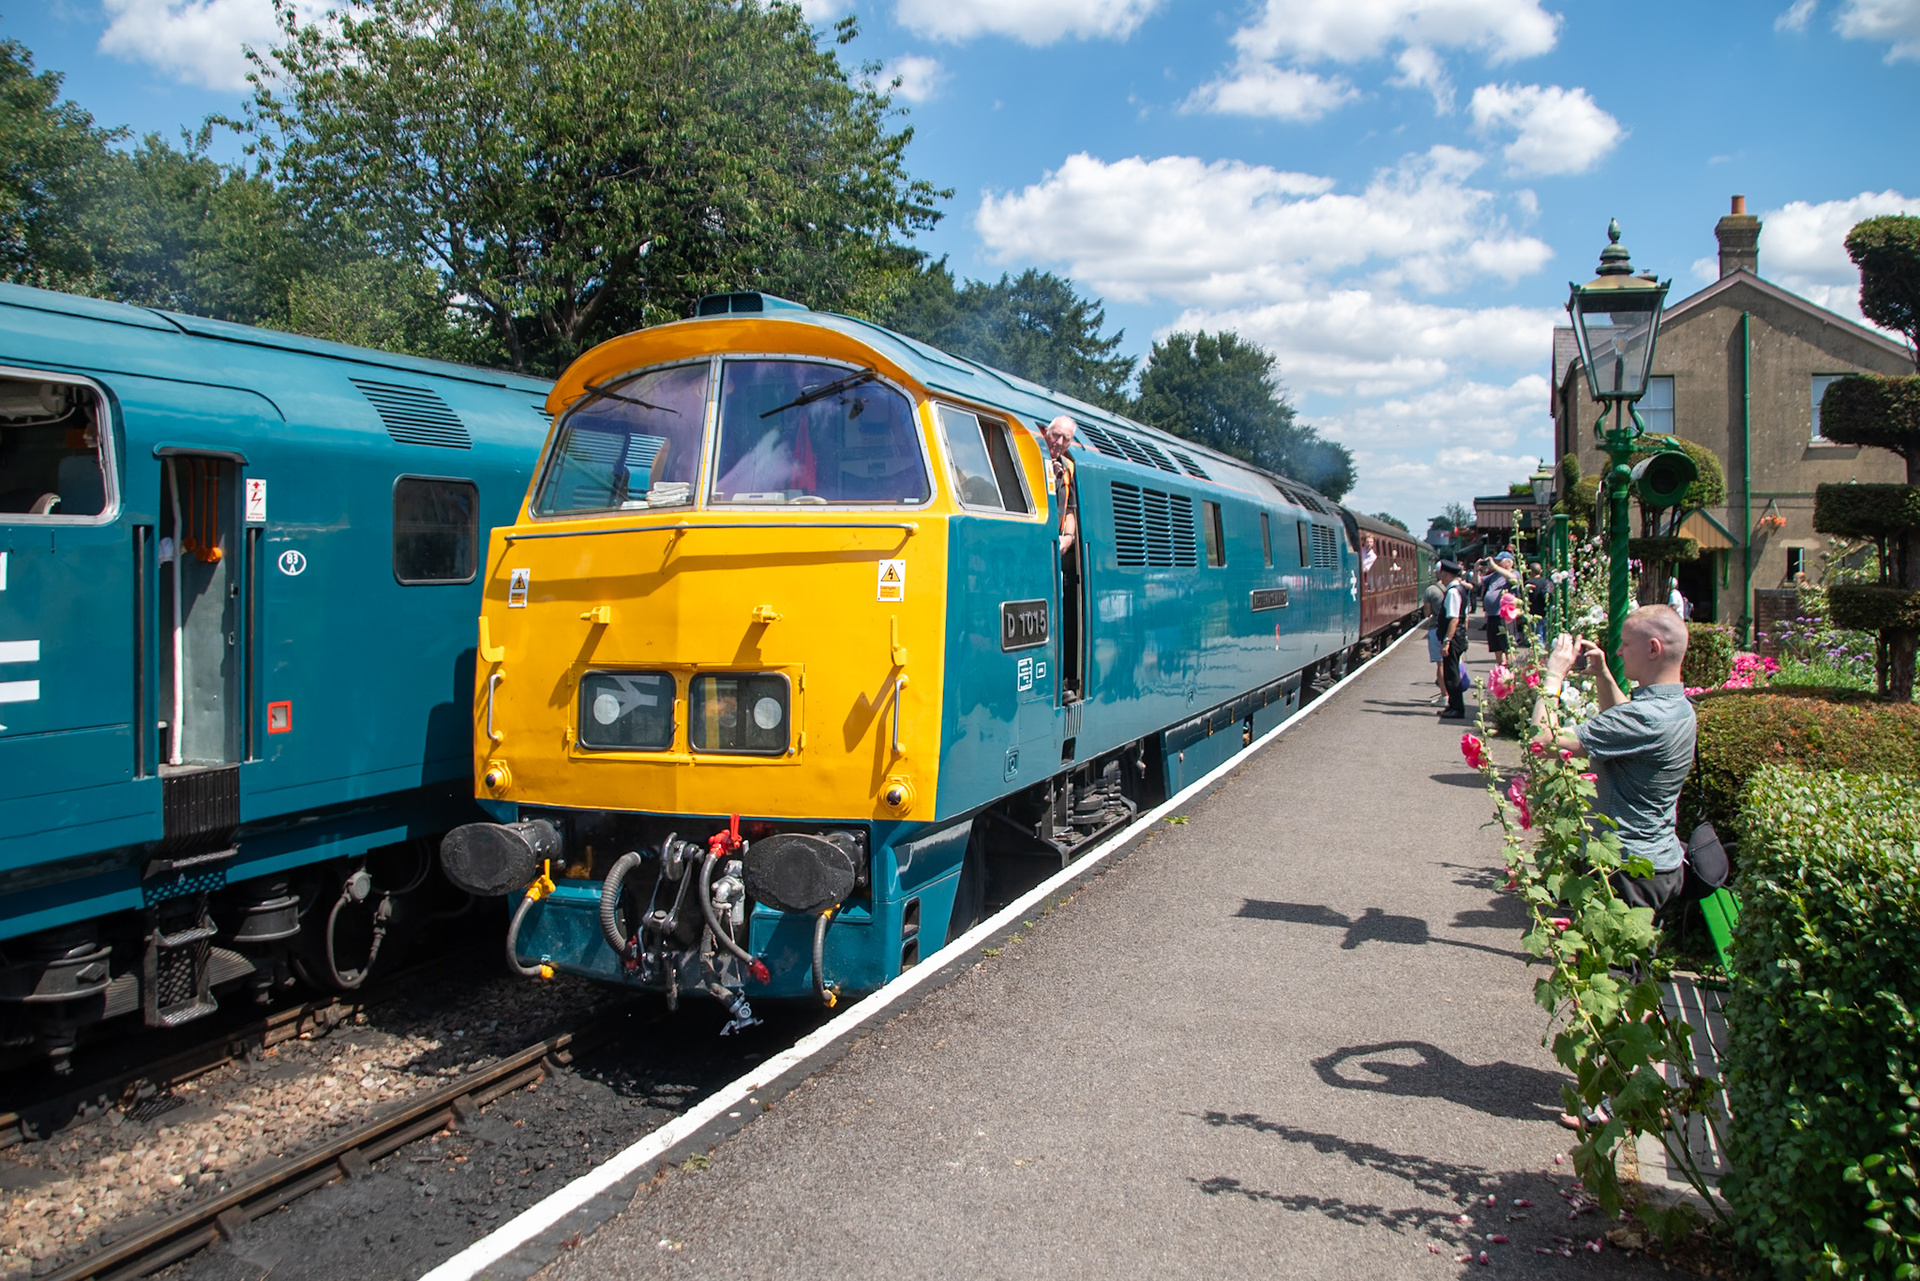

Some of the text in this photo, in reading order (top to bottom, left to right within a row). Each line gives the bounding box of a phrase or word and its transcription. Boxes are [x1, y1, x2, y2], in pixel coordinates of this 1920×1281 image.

[286, 553, 298, 565] 83
[1006, 609, 1047, 638] D 1015
